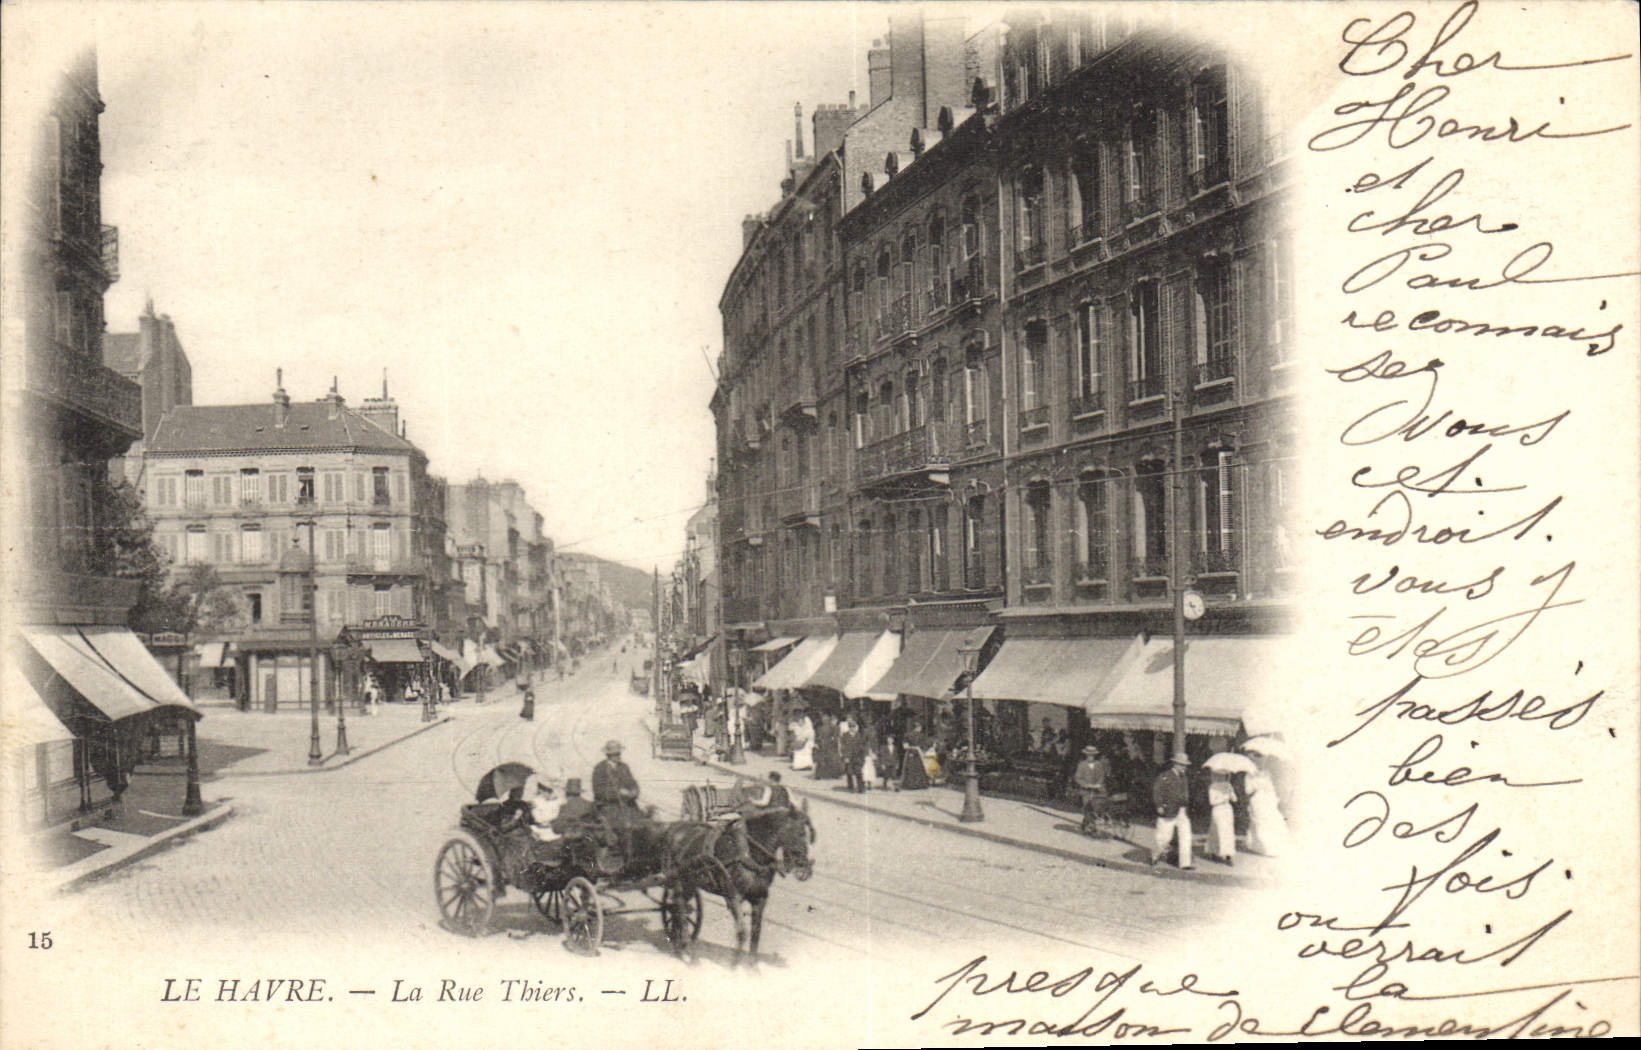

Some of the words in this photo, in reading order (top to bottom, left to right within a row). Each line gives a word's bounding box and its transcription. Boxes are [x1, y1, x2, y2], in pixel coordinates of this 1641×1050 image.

[1338, 0, 1633, 80] Cher
[1307, 81, 1632, 152] Henri
[1347, 168, 1519, 235] cher
[1342, 241, 1641, 294] Paul
[1352, 565, 1505, 601] vous
[1388, 734, 1584, 787] bien
